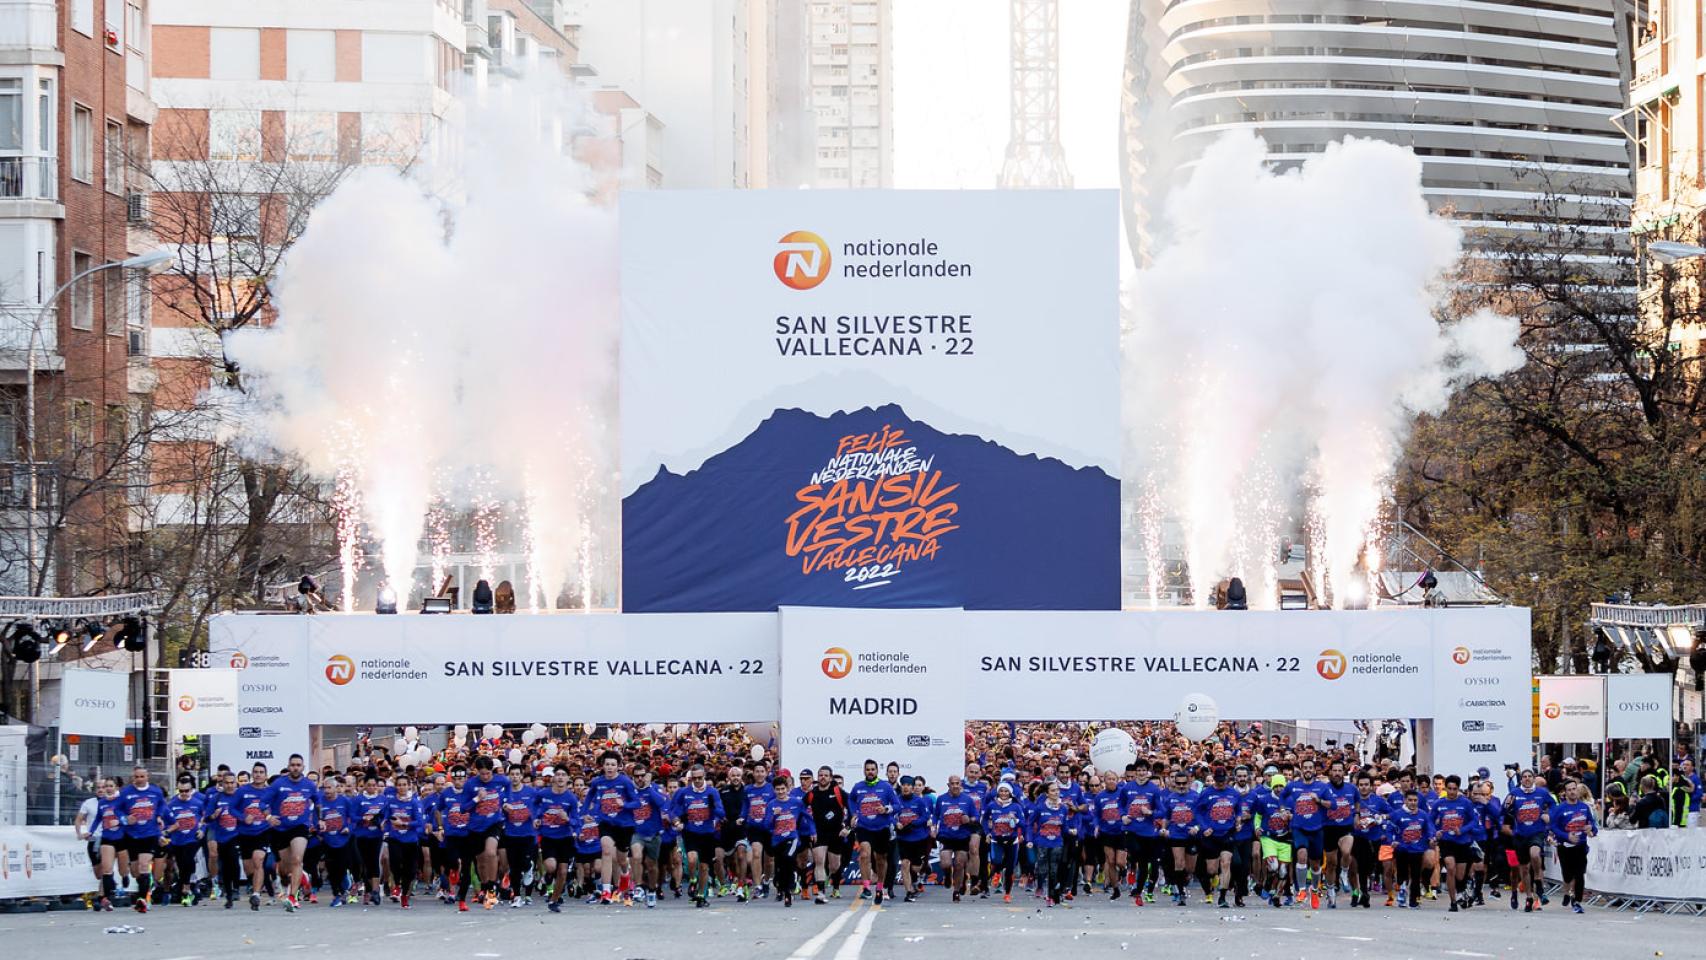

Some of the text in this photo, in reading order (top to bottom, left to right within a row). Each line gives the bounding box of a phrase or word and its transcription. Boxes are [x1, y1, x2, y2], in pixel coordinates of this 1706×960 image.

[843, 238, 939, 256] nationale
[843, 260, 972, 279] nederlanden
[775, 315, 973, 335] SAN SILVESTRE
[775, 337, 923, 356] VALLECANA
[944, 337, 975, 356] 22
[828, 446, 917, 471] NATIONALE
[810, 454, 935, 486] NEDERLANDEN
[795, 470, 961, 517] SANSIL
[784, 502, 960, 557] VESTRE
[802, 538, 943, 575] VALLECANA
[844, 563, 902, 583] 2022
[361, 658, 410, 668] nationale
[858, 651, 910, 662] nationale
[1352, 652, 1402, 663] nationale
[444, 661, 485, 677] SAN
[492, 661, 599, 677] SILVESTRE
[607, 659, 723, 676] VALLECANA
[739, 659, 764, 675] 22
[858, 663, 927, 674] nederlanden
[981, 656, 1022, 672] SAN
[1028, 656, 1137, 672] SILVESTRE
[1143, 657, 1260, 672] VALLECANA
[1275, 656, 1301, 672] 22
[1352, 663, 1419, 675] nederlanden
[361, 669, 428, 680] nederlanden
[1464, 677, 1500, 686] OYSHO
[242, 683, 277, 692] OYSHO
[74, 698, 116, 710] OYSHO
[829, 696, 919, 716] MADRID
[1618, 702, 1660, 711] OYSHO
[796, 736, 833, 745] OYSHO
[246, 750, 274, 759] MARCA
[1468, 744, 1497, 752] MARCA
